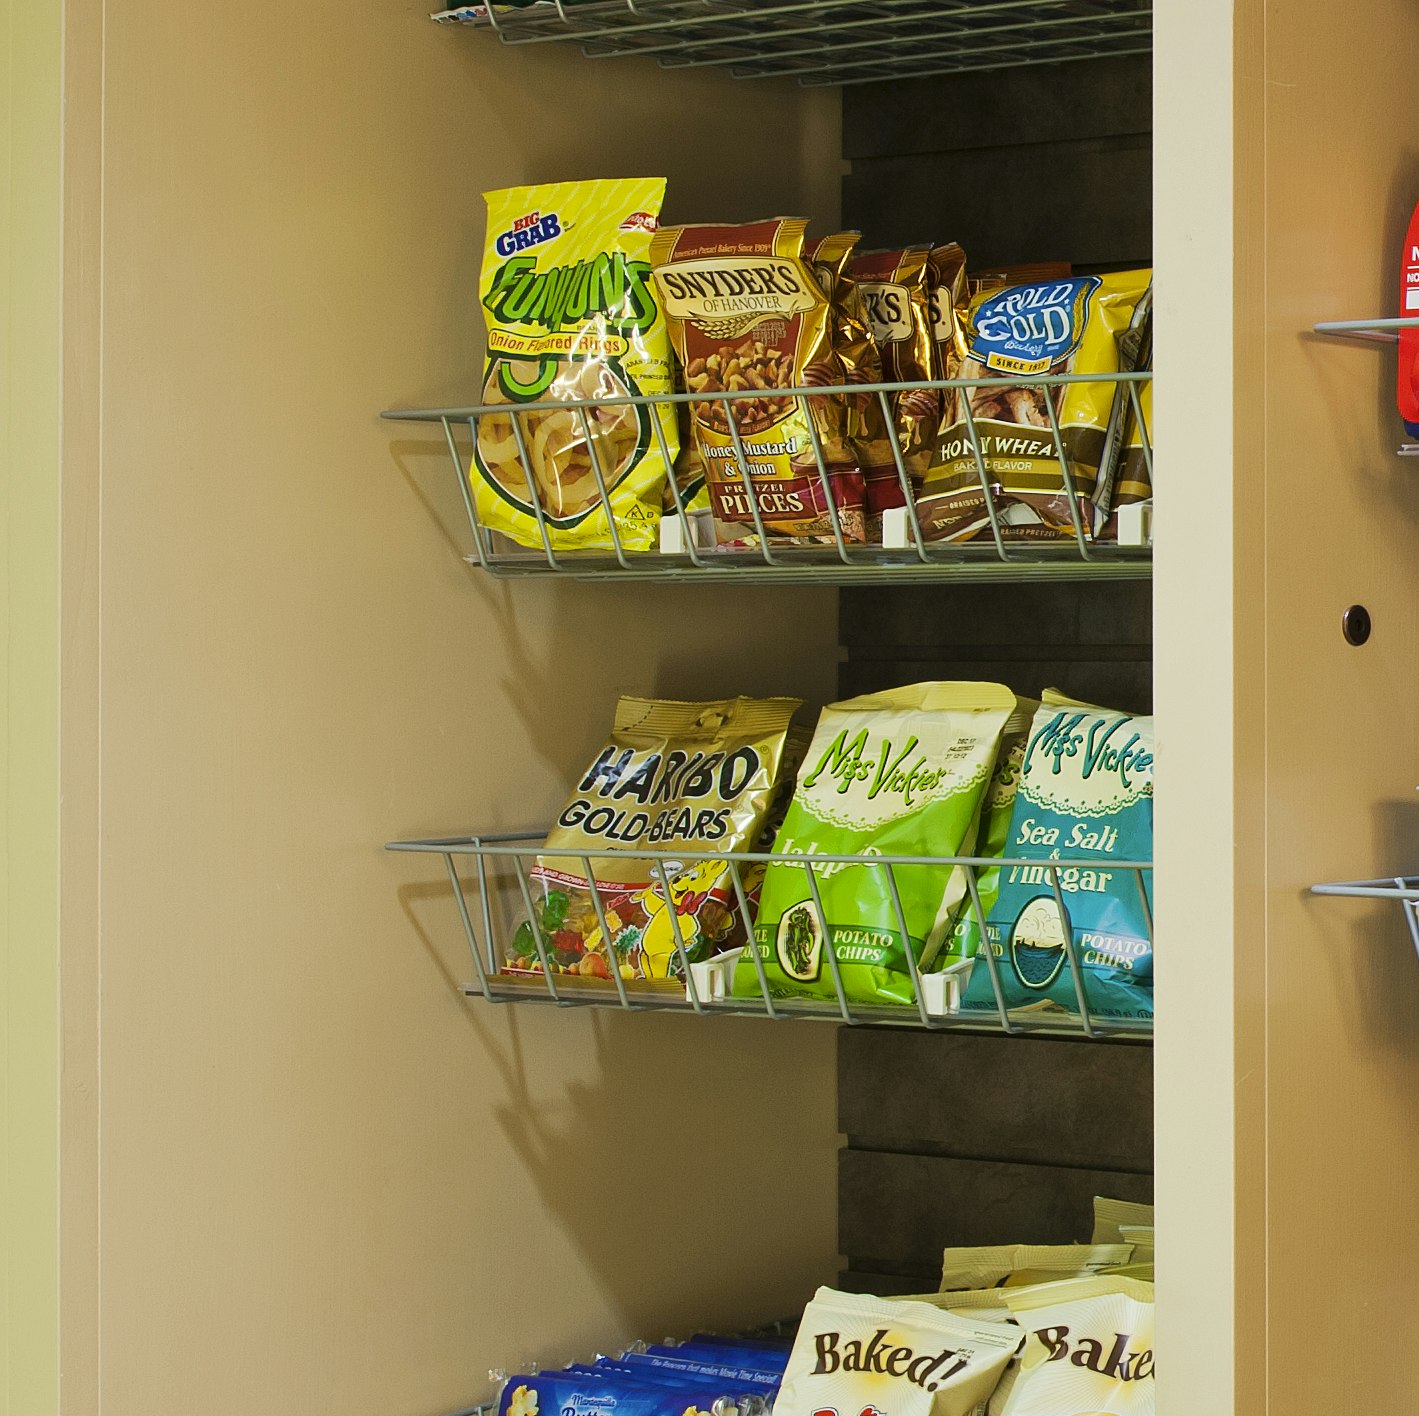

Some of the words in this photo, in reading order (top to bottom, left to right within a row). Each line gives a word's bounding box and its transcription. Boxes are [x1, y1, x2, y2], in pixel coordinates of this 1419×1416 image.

[513, 212, 539, 232] BIG
[497, 214, 561, 256] GRAB
[663, 264, 800, 300] SNYDER'S
[1407, 272, 1417, 282] NO
[703, 300, 720, 312] OF
[722, 296, 781, 312] HANOVER
[994, 284, 1073, 315] ROLD
[977, 307, 1071, 345] GOLD
[490, 333, 524, 350] Onion
[996, 358, 1024, 370] SINCE
[704, 443, 738, 458] Honey
[724, 463, 736, 477] &
[993, 461, 1032, 470] FLAVOR
[1024, 712, 1086, 774] Miss
[579, 746, 759, 804] HARIBO
[804, 729, 873, 793] Miss
[868, 735, 946, 806] Vickie's
[559, 801, 730, 842] GOLD-BEARS
[1017, 819, 1059, 846] Sea
[1065, 823, 1118, 852] Salt
[1009, 858, 1112, 893] Vinegar
[834, 931, 893, 947] POTATO
[1081, 934, 1147, 956] POTATO
[836, 946, 881, 960] CHIPS
[1084, 950, 1134, 970] CHIPS
[810, 1329, 969, 1392] Baked!
